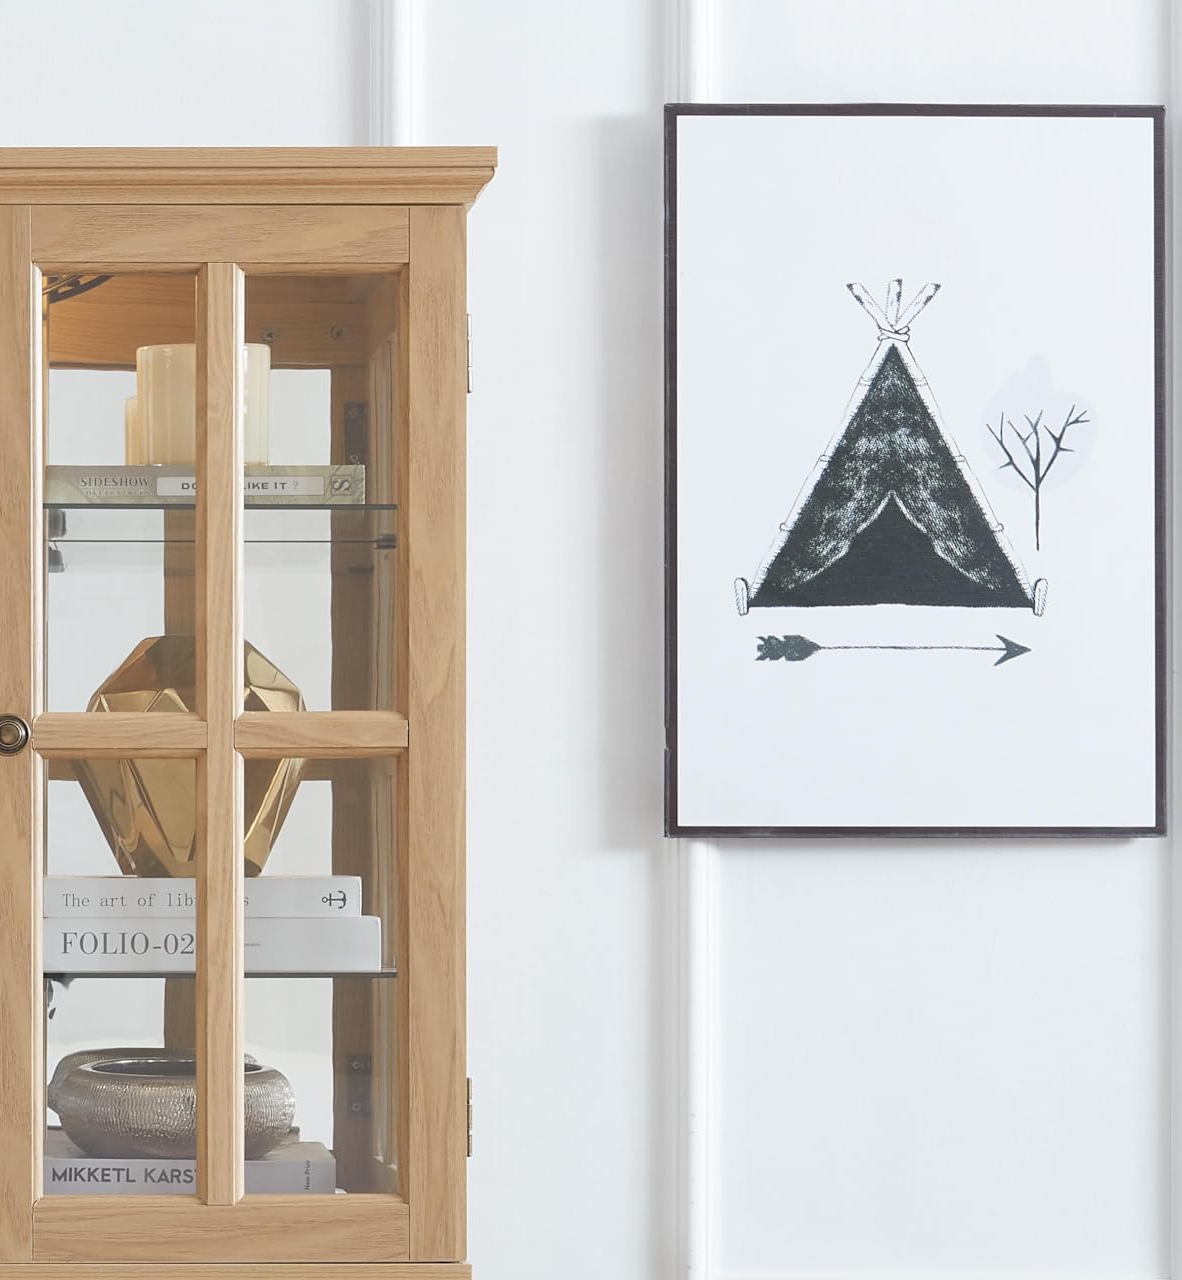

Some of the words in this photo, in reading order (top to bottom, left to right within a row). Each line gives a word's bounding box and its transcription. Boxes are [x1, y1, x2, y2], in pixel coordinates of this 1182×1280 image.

[80, 477, 149, 487] SIDESHOW
[274, 482, 287, 490] IT
[62, 892, 90, 907] The
[99, 894, 127, 907] art
[137, 892, 157, 907] of
[60, 931, 195, 955] FOLIO-02
[51, 1167, 137, 1183] MIKKETL
[144, 1168, 197, 1184] KARS
